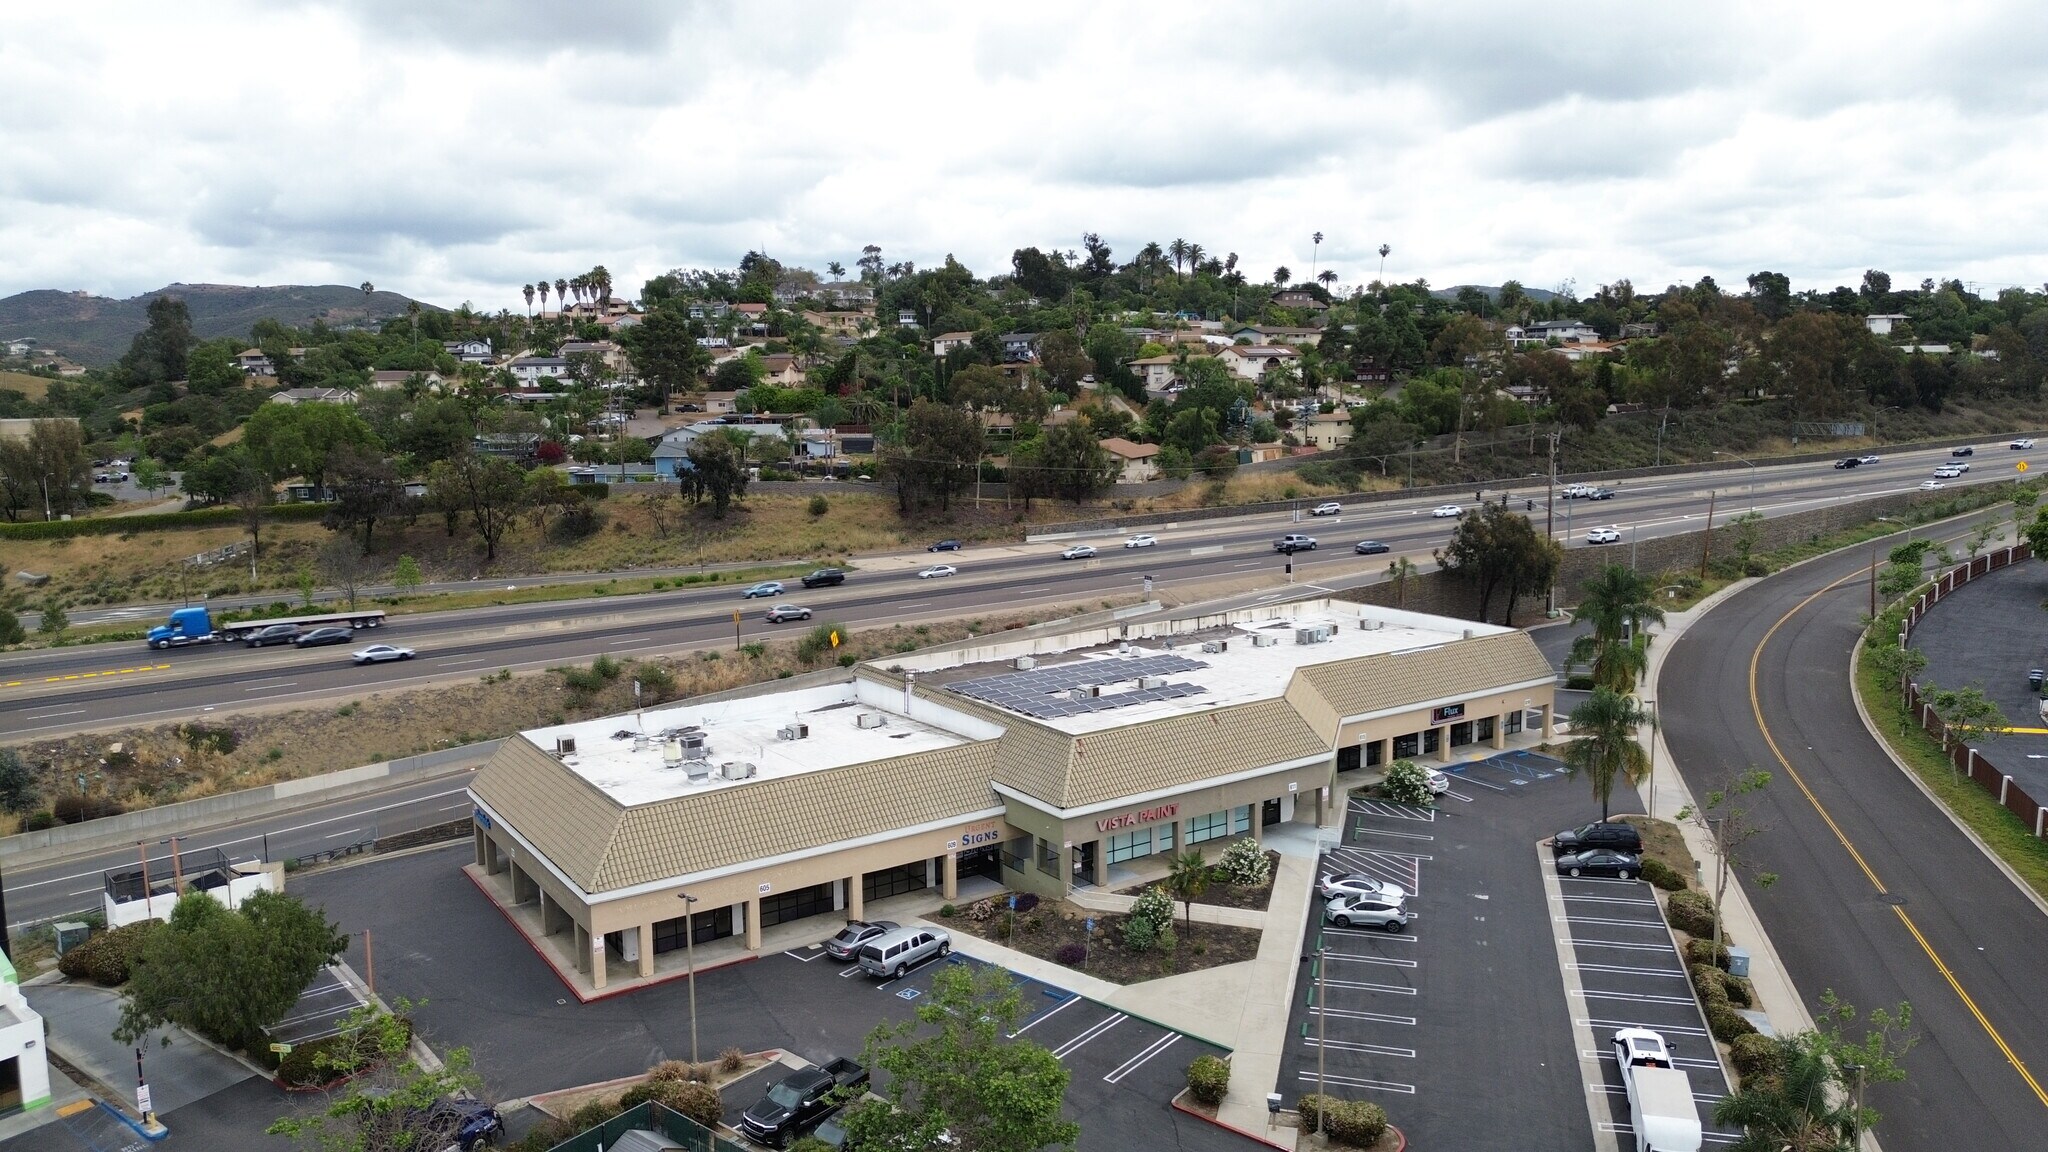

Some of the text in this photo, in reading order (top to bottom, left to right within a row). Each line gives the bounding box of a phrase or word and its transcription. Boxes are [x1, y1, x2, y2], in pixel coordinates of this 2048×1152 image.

[1444, 707, 1459, 716] Flux
[1097, 803, 1179, 832] VISTA PAINT
[965, 821, 995, 833] URGENT
[962, 830, 998, 846] SIGNS
